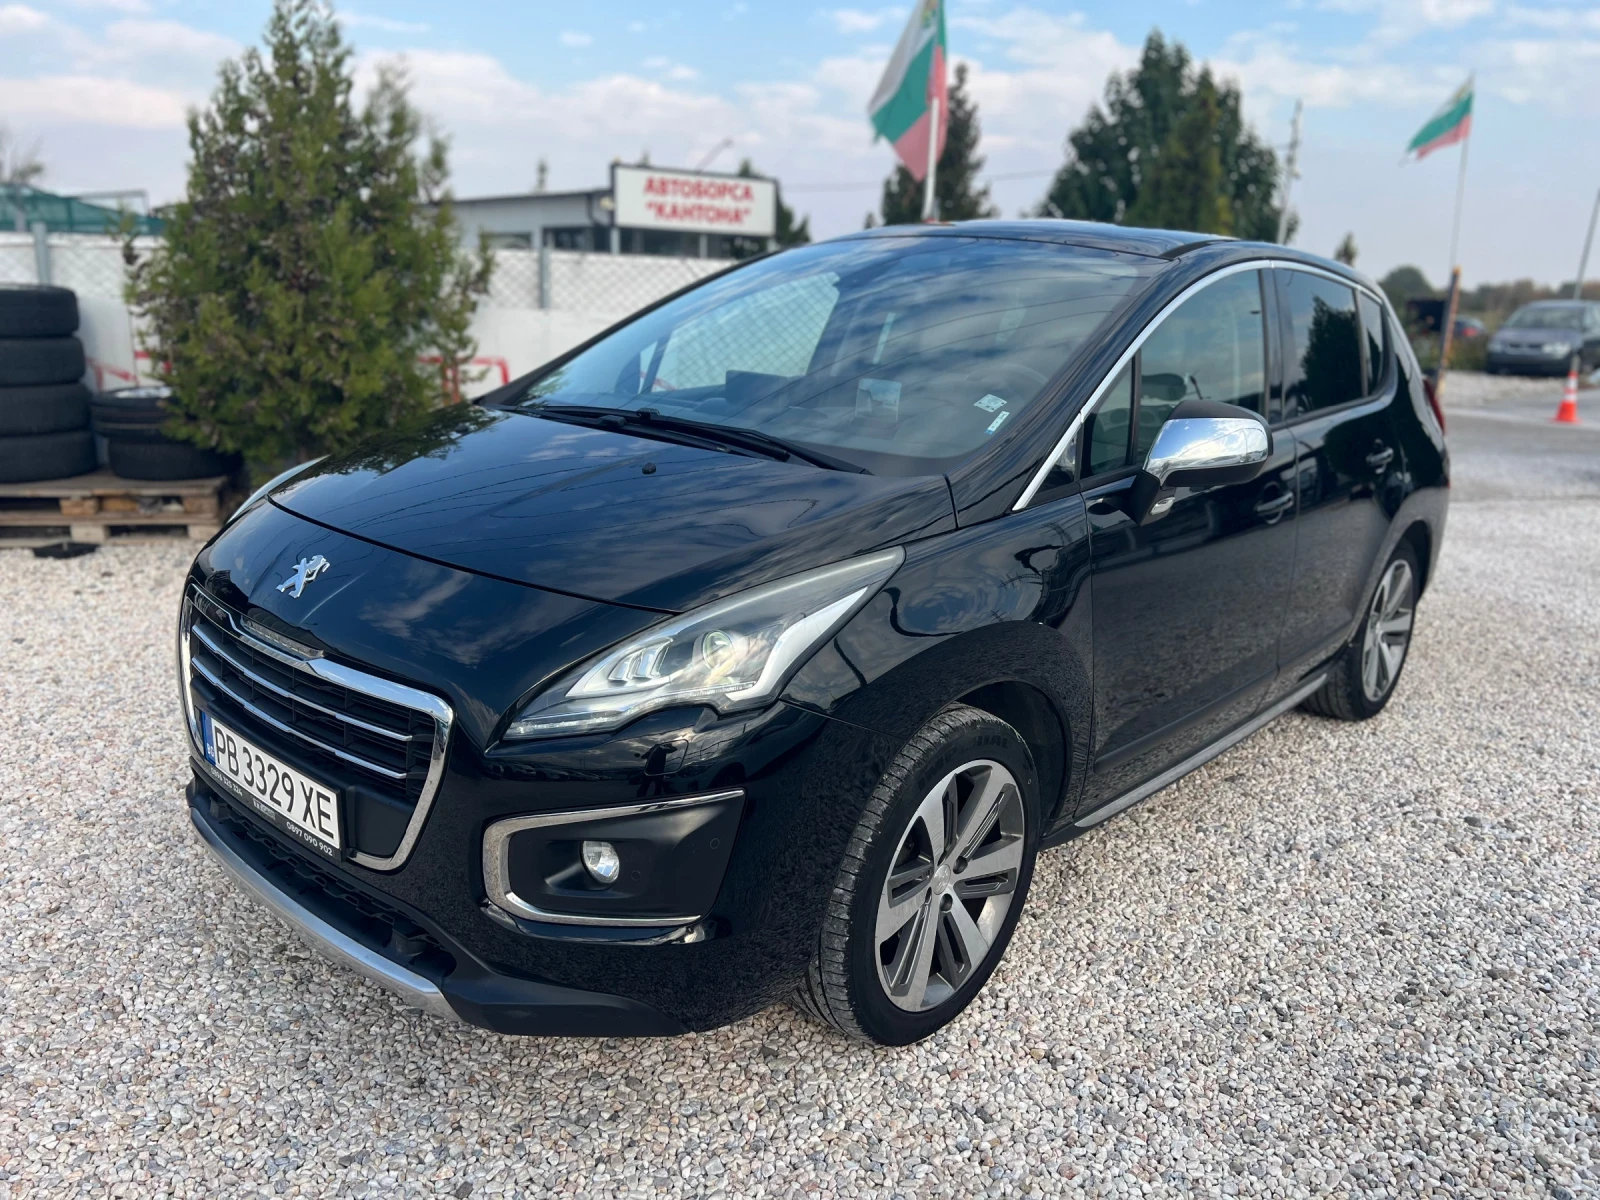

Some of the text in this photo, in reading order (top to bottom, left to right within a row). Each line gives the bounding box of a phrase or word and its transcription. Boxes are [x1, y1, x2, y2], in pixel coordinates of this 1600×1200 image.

[644, 176, 754, 201] АВТОБОРСА
[214, 726, 335, 840] PB 3329 XE
[286, 821, 334, 857] 0897 090 902
